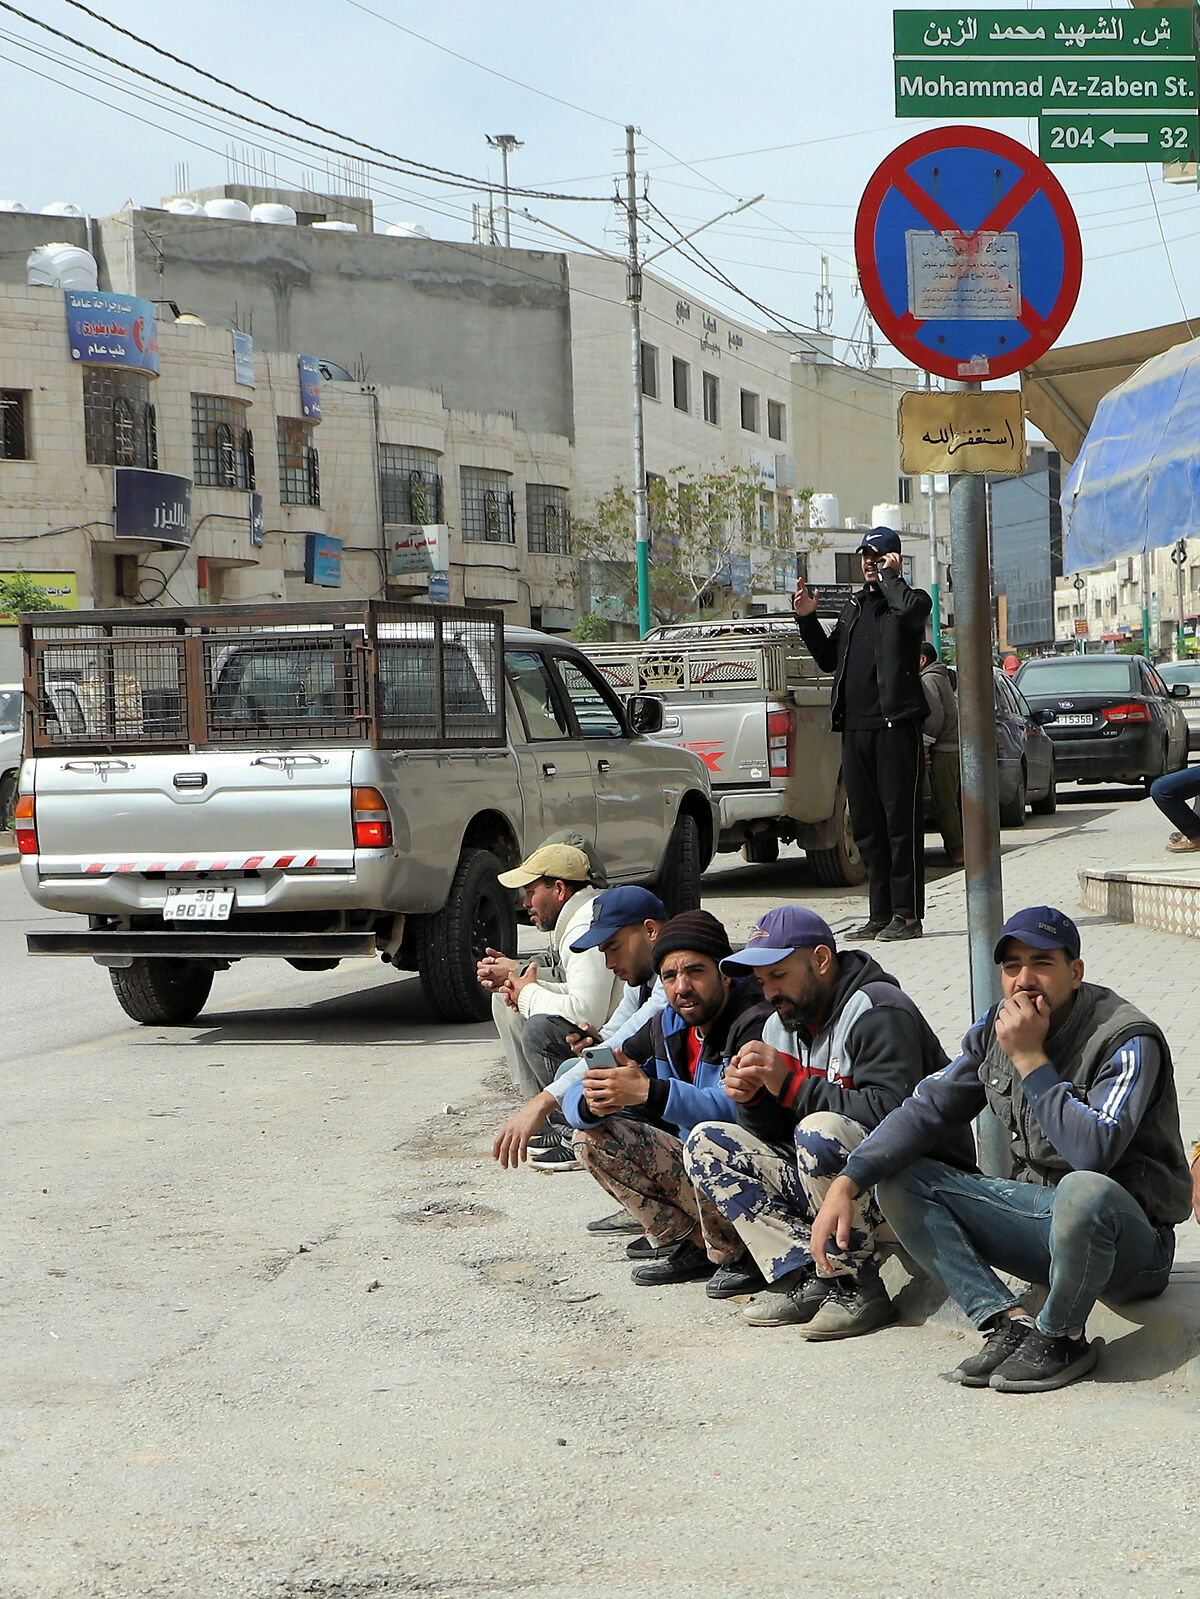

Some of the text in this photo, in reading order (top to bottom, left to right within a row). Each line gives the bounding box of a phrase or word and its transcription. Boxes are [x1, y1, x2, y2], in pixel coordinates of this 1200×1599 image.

[989, 22, 1046, 40] محمد
[1054, 16, 1124, 48] الشهيد
[900, 75, 1195, 97] Mohammad Az-Zaben St.
[1050, 127, 1189, 148] 204 32
[88, 343, 108, 356] عام
